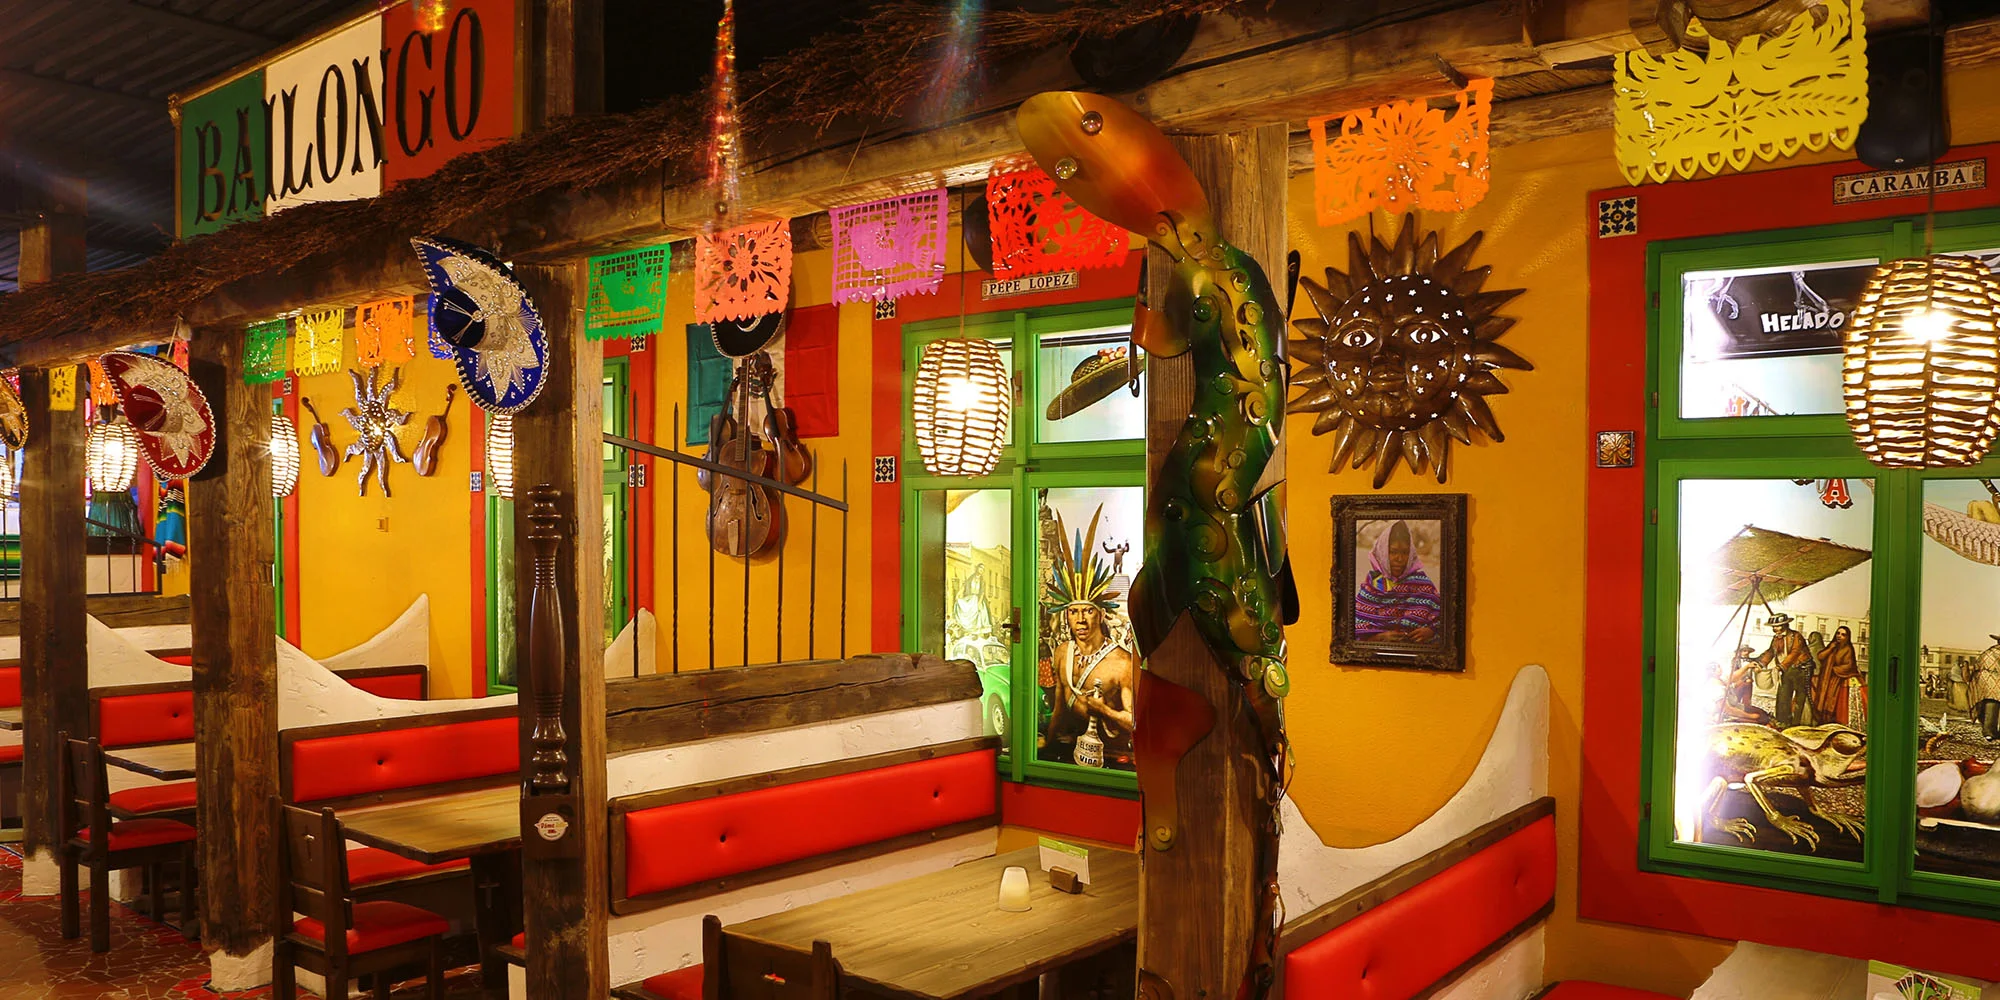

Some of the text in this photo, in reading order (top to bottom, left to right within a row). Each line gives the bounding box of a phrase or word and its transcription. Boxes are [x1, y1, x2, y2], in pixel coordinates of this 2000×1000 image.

[195, 7, 485, 226] BAILONGO
[1850, 169, 1966, 195] CARAMBA
[989, 274, 1070, 294] PEPE LOPEZ
[1760, 311, 1845, 333] HELADO
